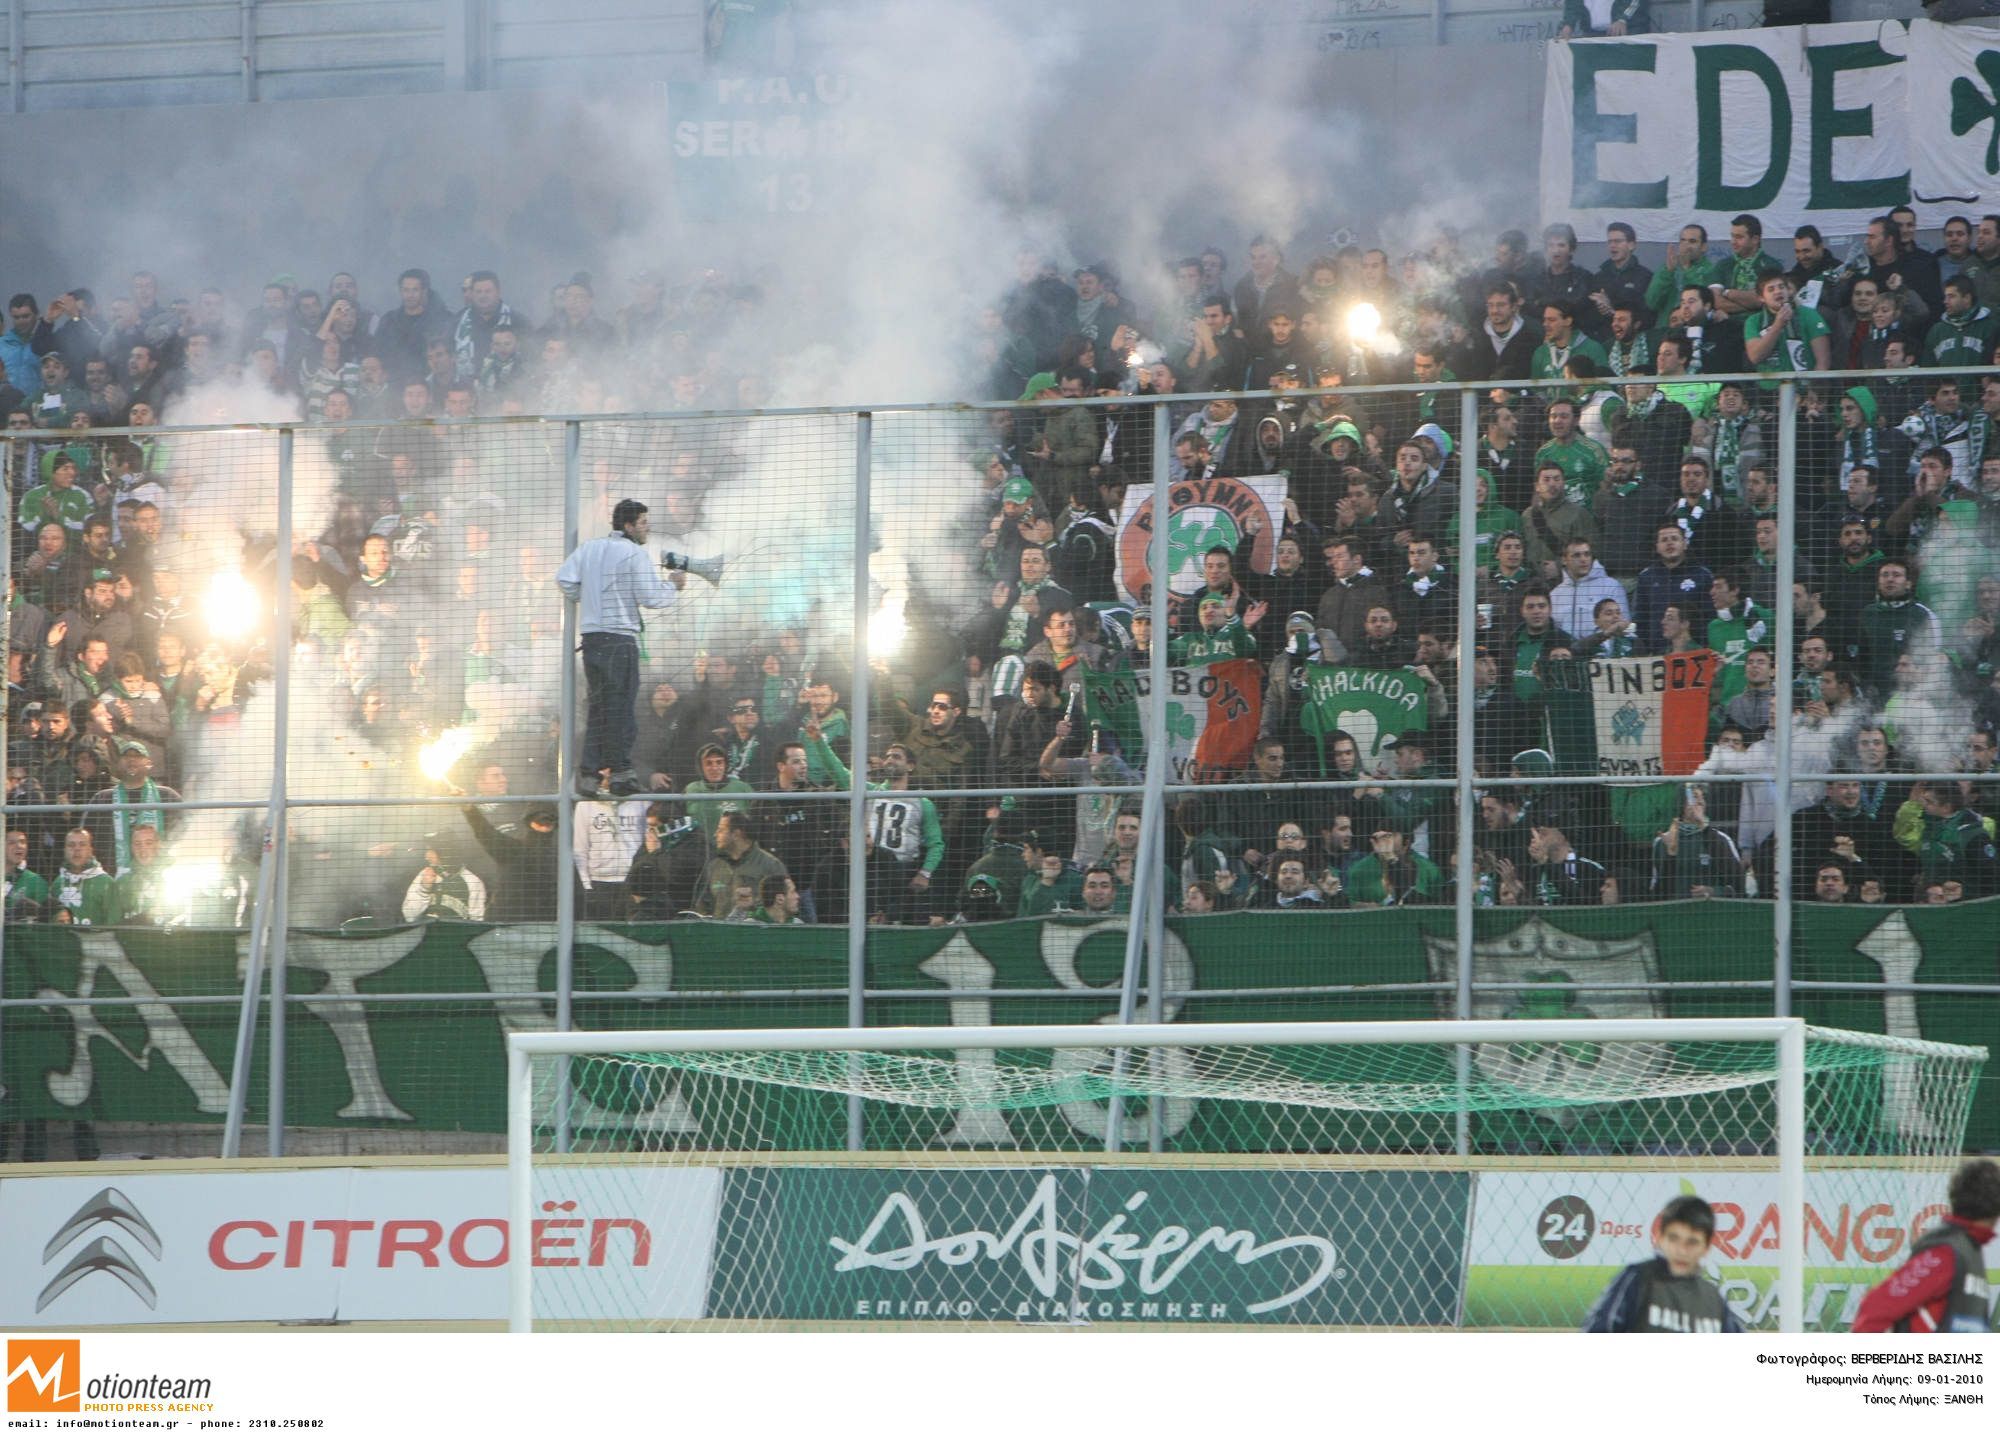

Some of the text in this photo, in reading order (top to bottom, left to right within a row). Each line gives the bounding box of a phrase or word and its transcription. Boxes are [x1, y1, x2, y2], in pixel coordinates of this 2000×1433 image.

[756, 172, 814, 213] 13
[1171, 669, 1250, 720] BOYS
[874, 802, 907, 849] 13
[918, 921, 1197, 1145] 13
[1542, 1213, 1587, 1242] 24
[1651, 1202, 1950, 1263] RANG
[856, 1299, 972, 1317] ΕΠΙΠΛΟ
[1016, 1299, 1228, 1318] ΔΙΑΚΟΣΜΗΣΗ
